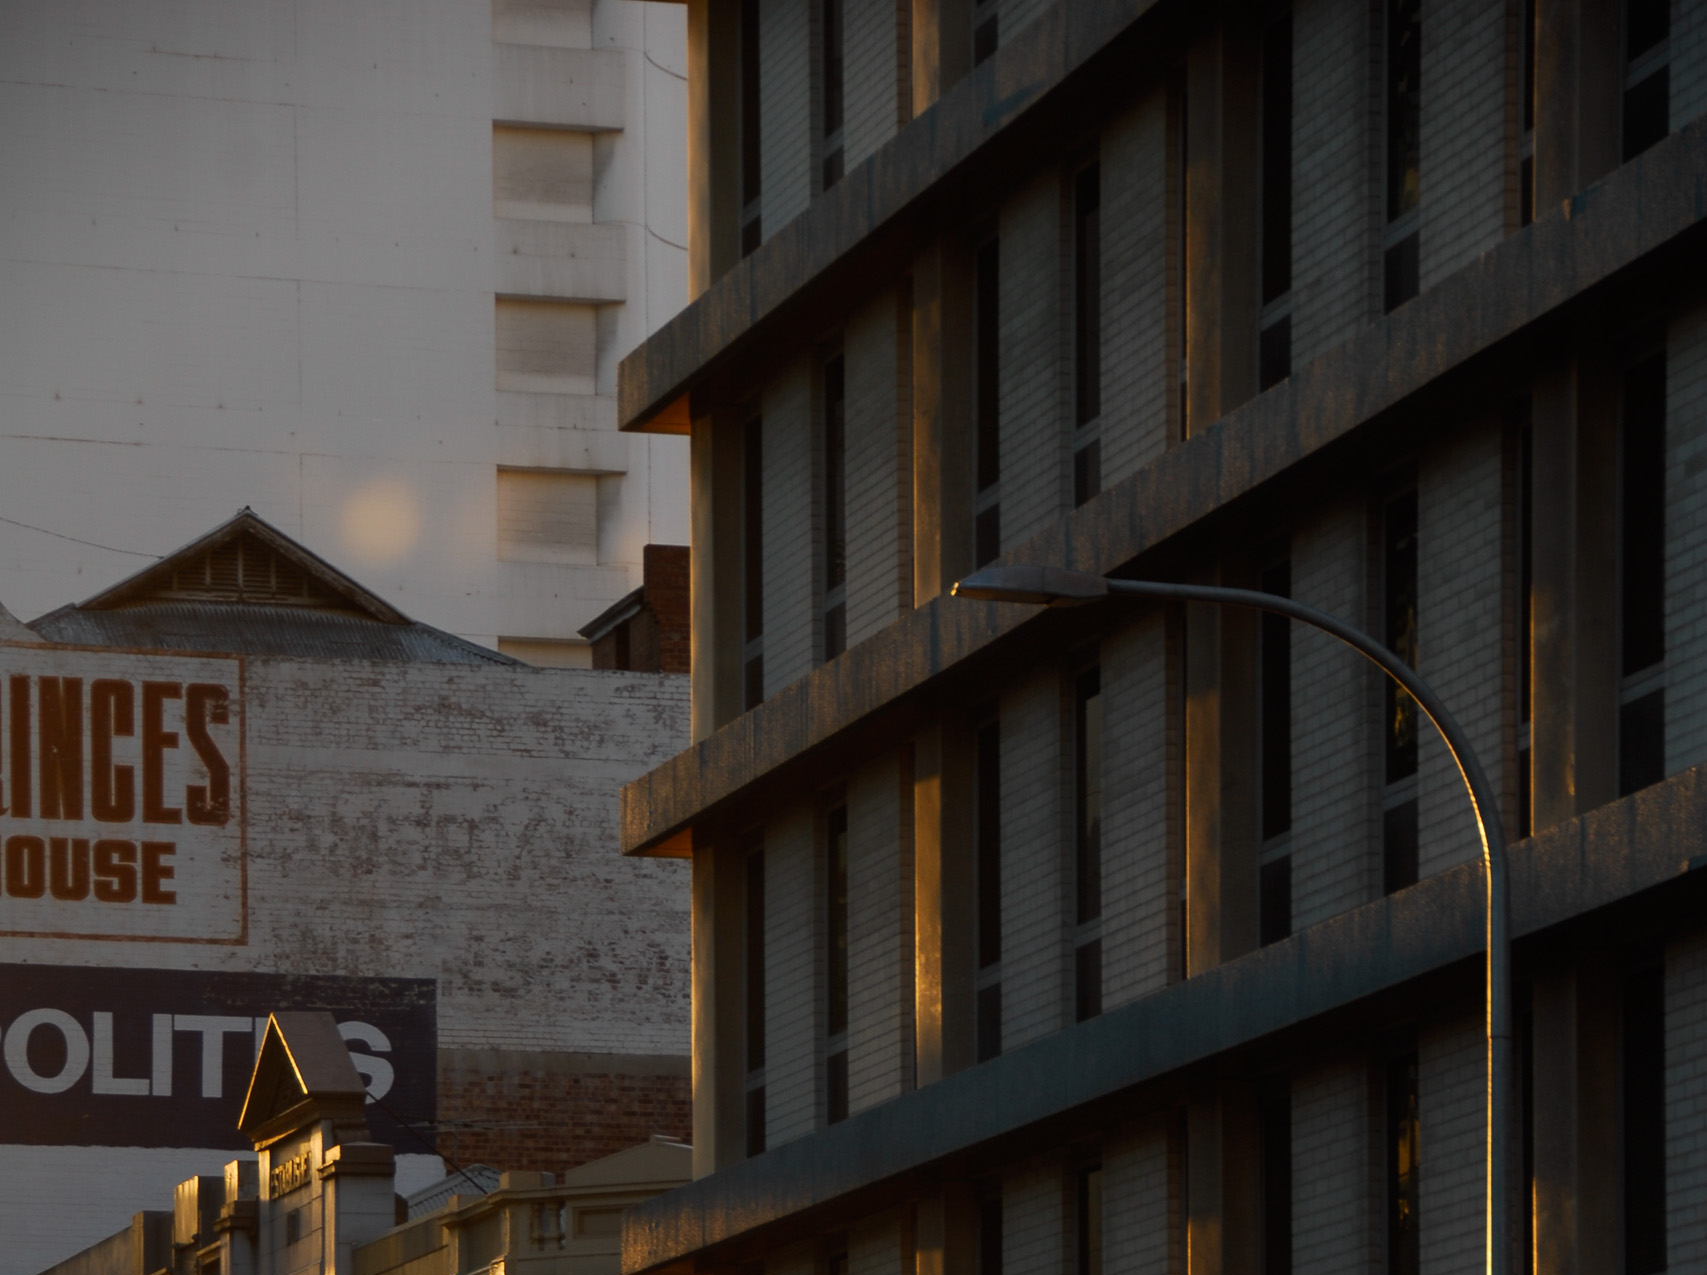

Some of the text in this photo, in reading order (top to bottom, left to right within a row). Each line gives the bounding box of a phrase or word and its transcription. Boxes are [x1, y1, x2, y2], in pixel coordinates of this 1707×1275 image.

[0, 674, 230, 826] INCES
[0, 835, 177, 904] OUSE
[0, 1007, 395, 1105] OLITS
